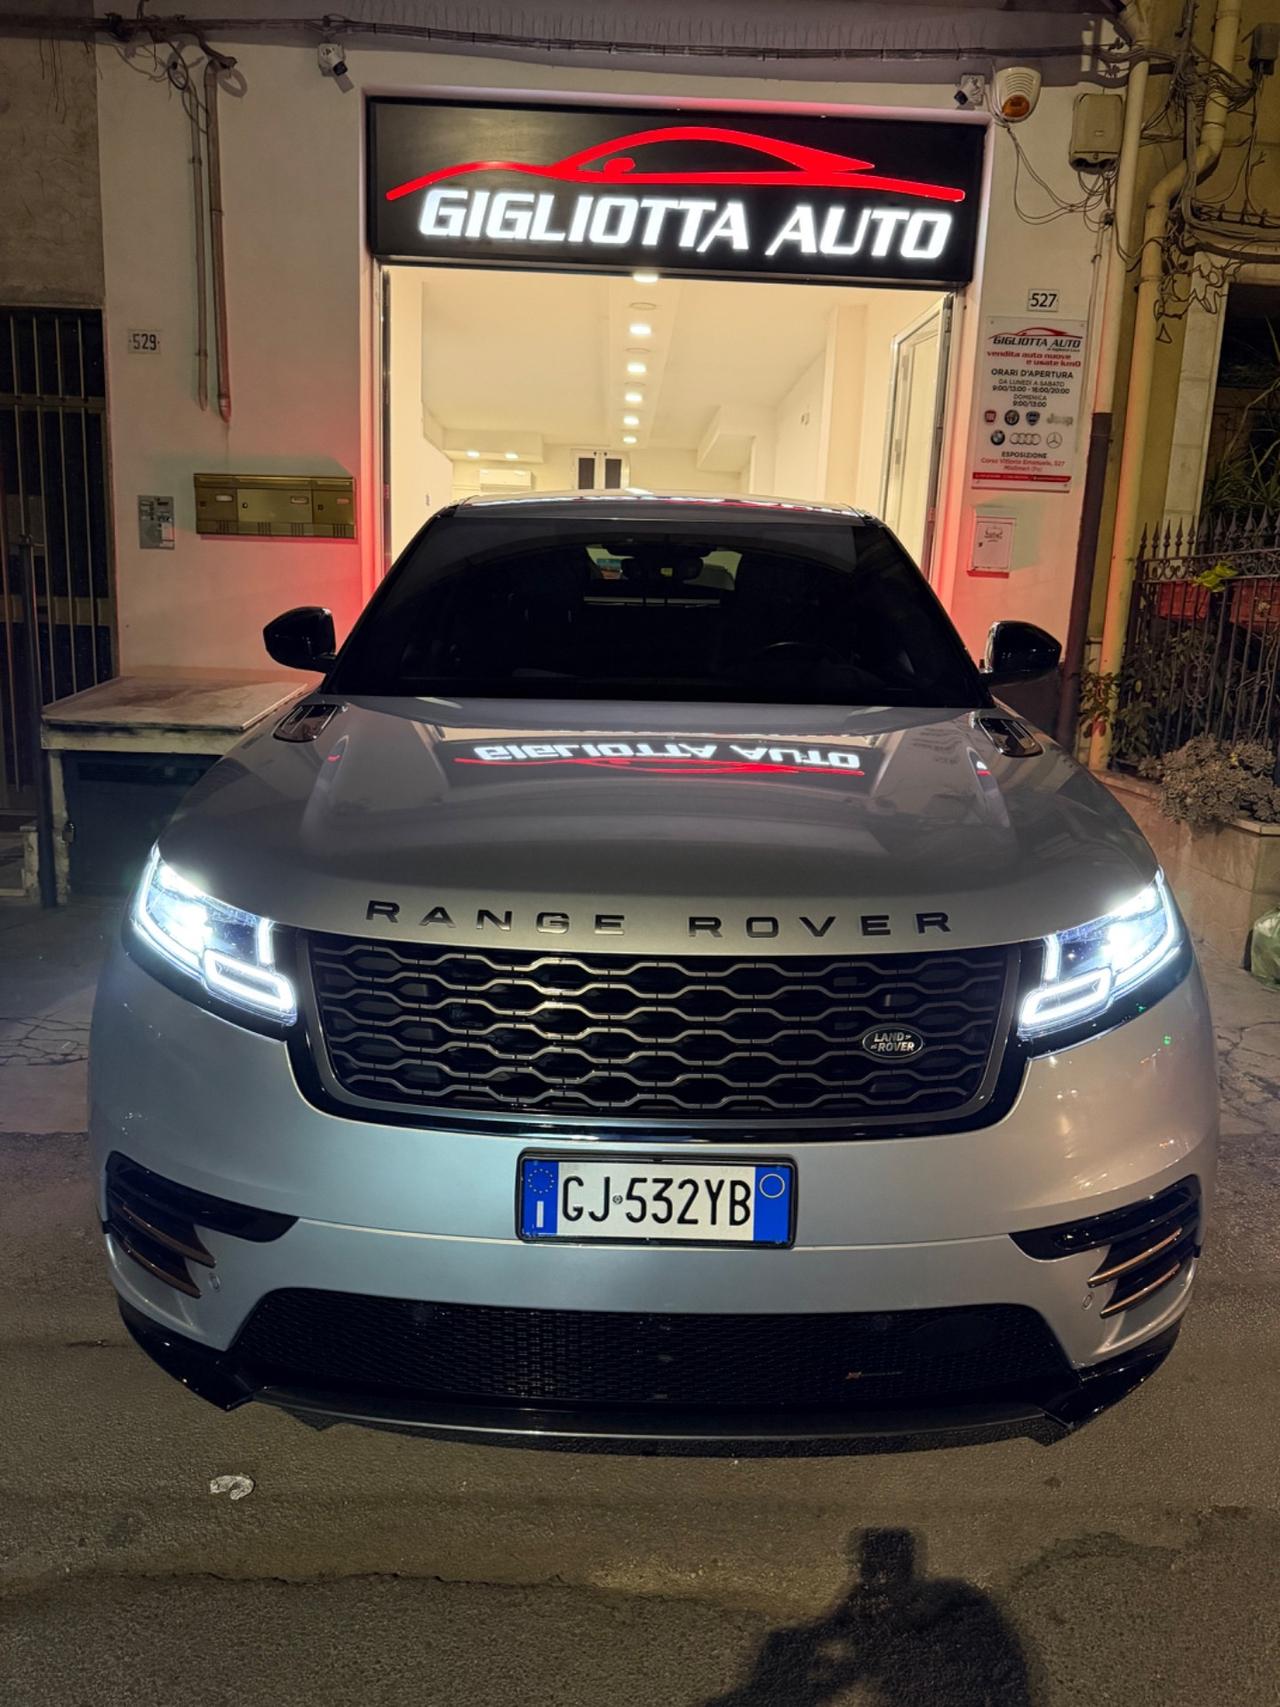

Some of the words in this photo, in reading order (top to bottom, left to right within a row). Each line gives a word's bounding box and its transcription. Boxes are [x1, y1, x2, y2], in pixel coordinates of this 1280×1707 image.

[418, 189, 750, 253] GIGLIOTTA
[765, 204, 953, 260] AUTO
[1030, 293, 1057, 308] 527
[132, 333, 157, 351] 529
[993, 336, 1047, 347] GIGLIOTTA
[1050, 339, 1081, 349] AUTO
[991, 368, 1018, 376] ORARI
[1021, 369, 1074, 379] D'APERTURA
[365, 900, 626, 935] RANGE
[688, 911, 952, 939] ROVER
[874, 1032, 905, 1043] LAND
[877, 1041, 915, 1052] ROVER
